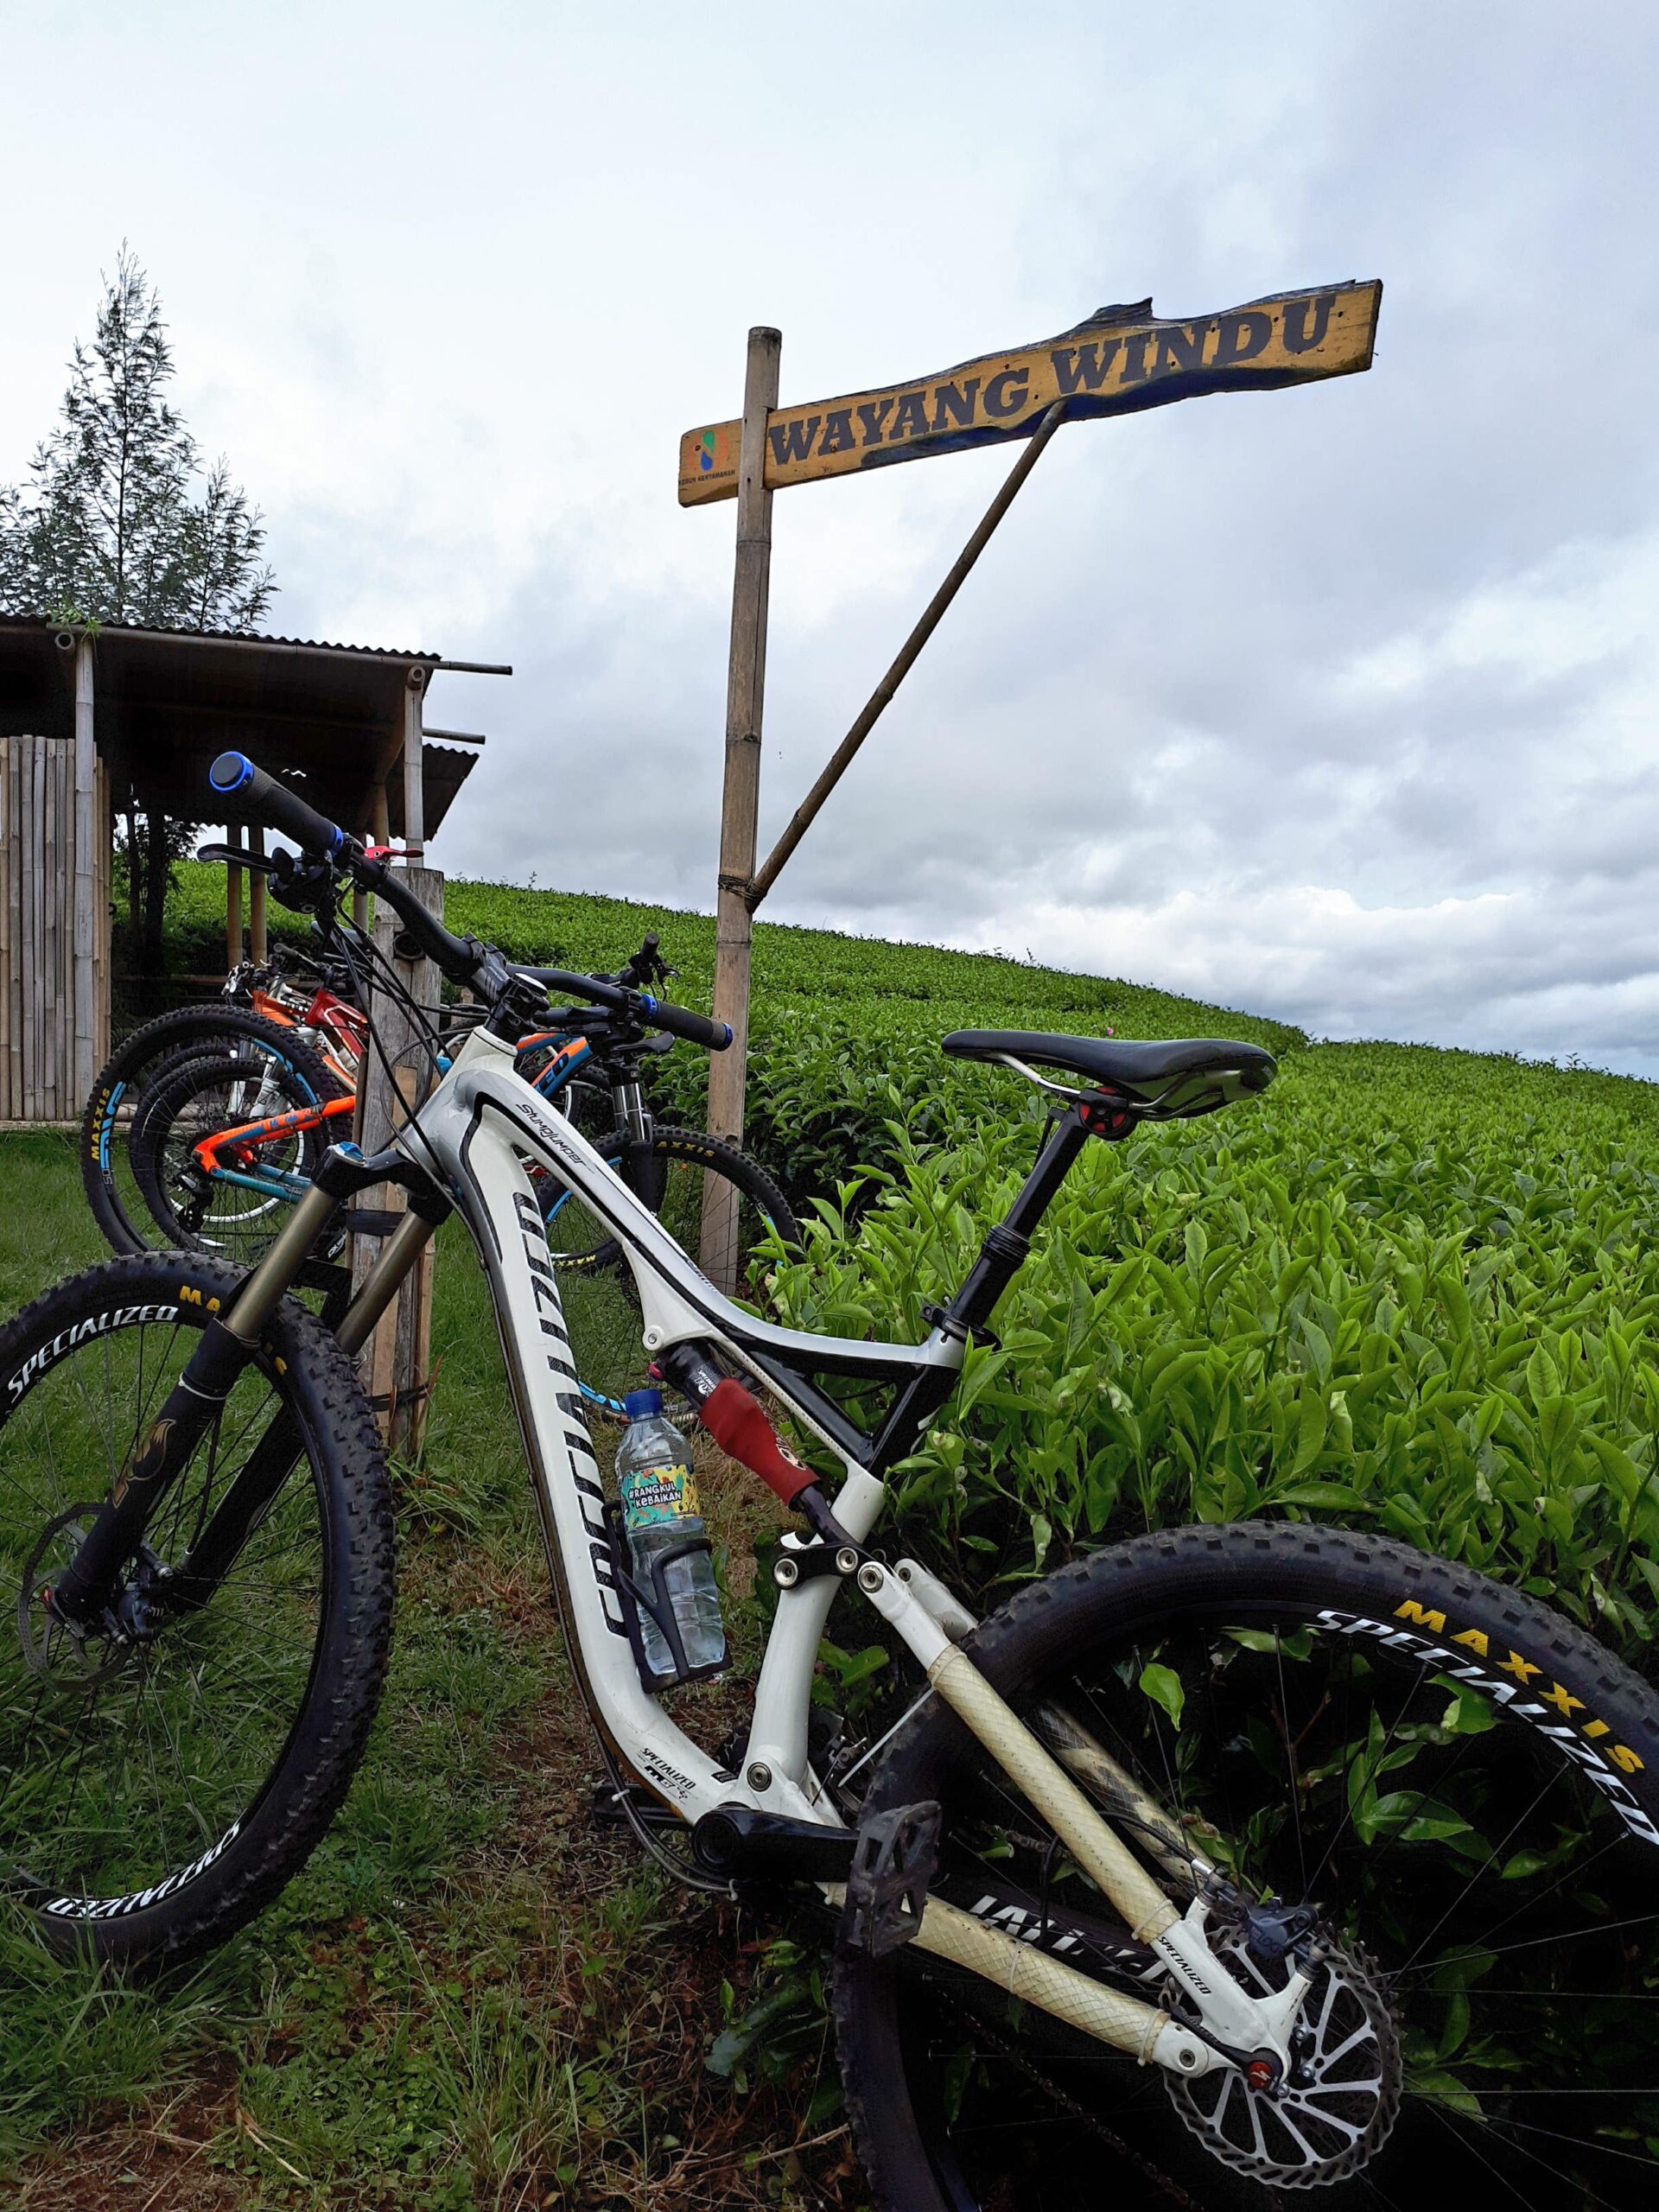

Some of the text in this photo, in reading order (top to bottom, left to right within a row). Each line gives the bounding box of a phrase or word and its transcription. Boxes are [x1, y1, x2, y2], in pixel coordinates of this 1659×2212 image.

[767, 295, 1336, 466] WAYANG WINDU
[90, 1088, 111, 1160] MAXXIS
[655, 1140, 715, 1158] AXXIS
[6, 1305, 179, 1404] SPECIALIZED
[628, 1482, 677, 1500] #RANGKUL
[1393, 1599, 1645, 1773] MAXXIS
[1304, 1609, 1659, 1847] SPECIALIZED
[641, 1747, 696, 1790] SPECIALIZED
[1156, 1936, 1211, 1995] SPECIALIZED
